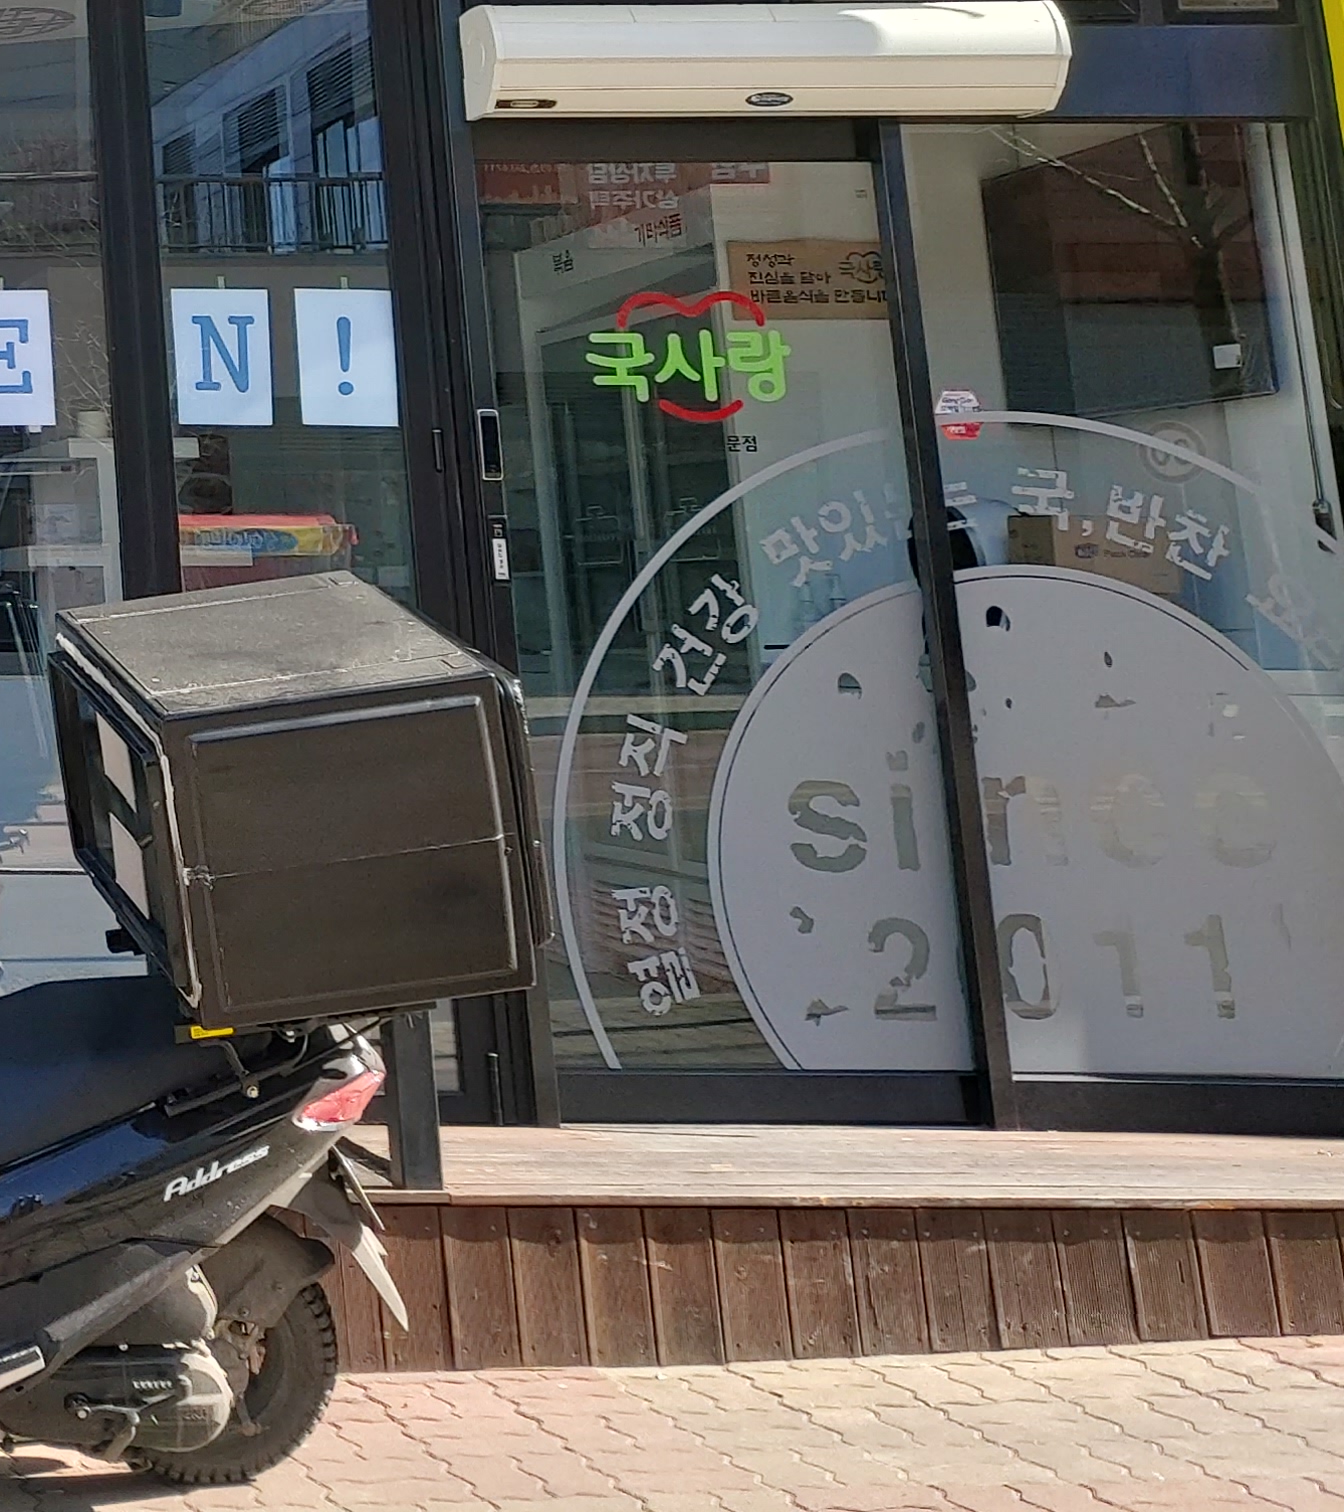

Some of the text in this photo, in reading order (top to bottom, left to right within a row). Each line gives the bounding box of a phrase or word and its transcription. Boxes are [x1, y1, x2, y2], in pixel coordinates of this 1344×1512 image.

[585, 328, 792, 404] 국사랑
[652, 572, 759, 696] 건강
[610, 713, 688, 842] 정직
[611, 884, 701, 1016] 열정
[164, 1145, 270, 1203] Address
